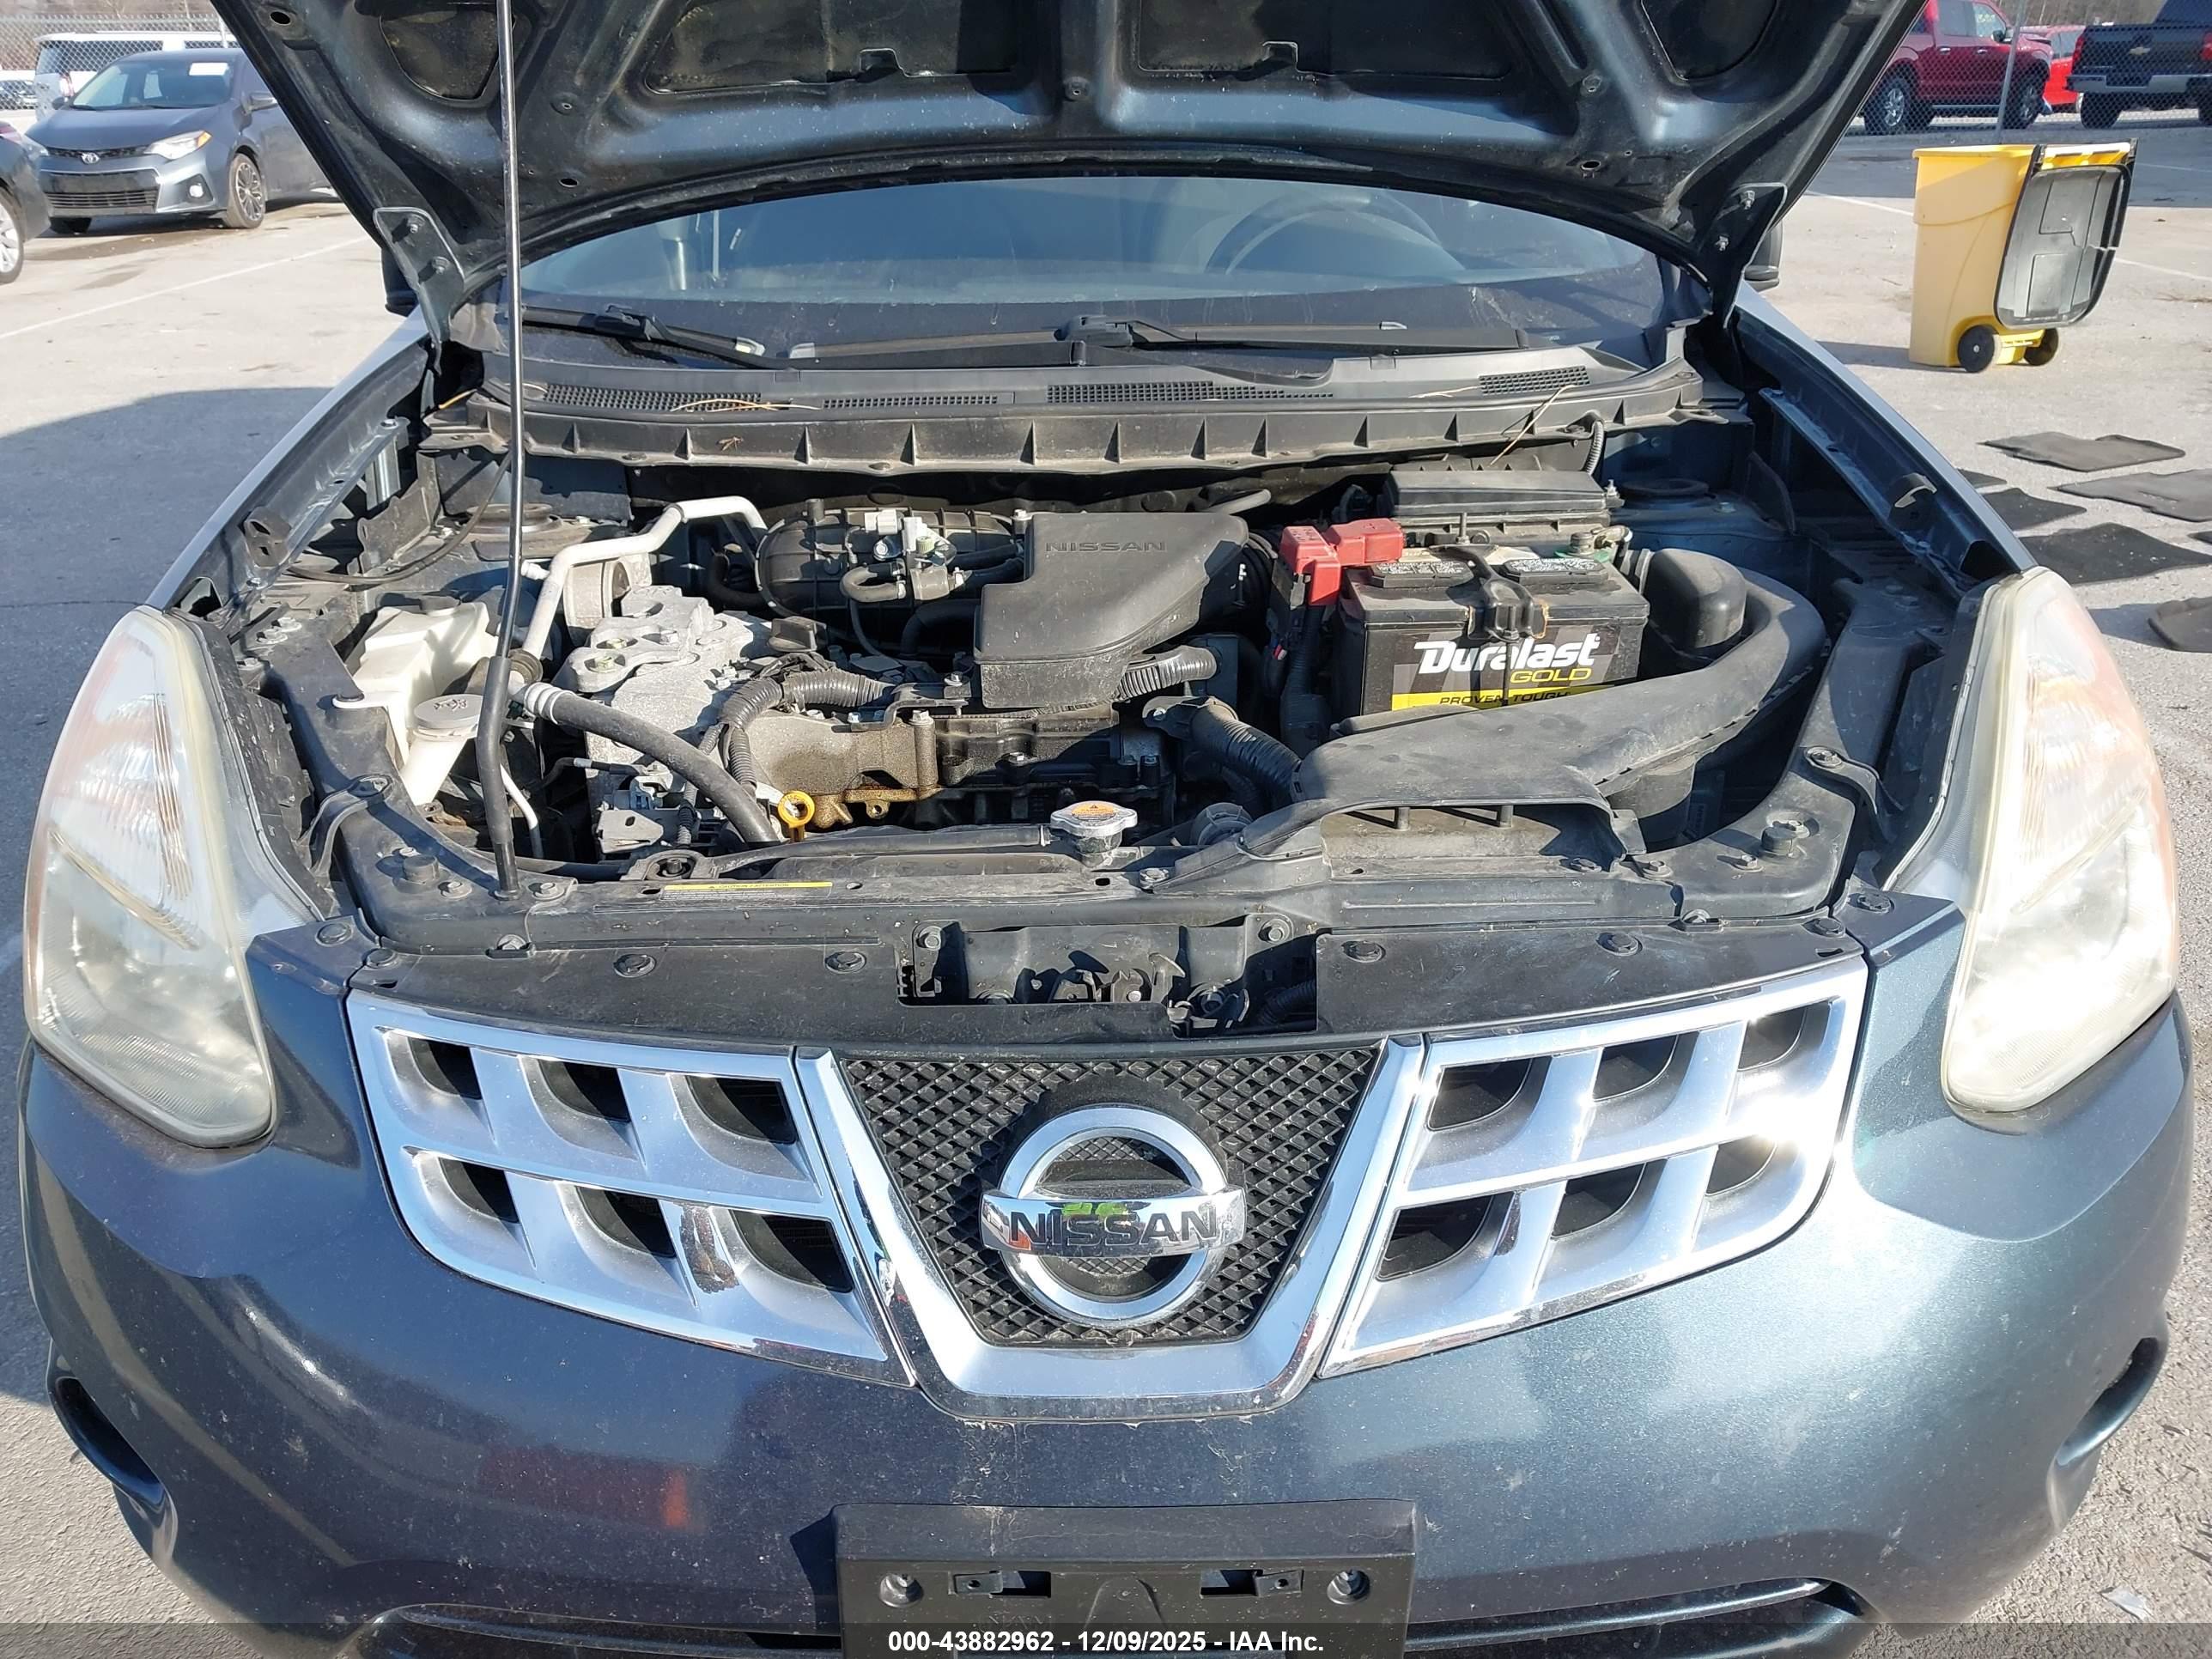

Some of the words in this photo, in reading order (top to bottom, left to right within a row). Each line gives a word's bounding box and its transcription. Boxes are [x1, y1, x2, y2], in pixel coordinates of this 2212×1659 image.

[1045, 542, 1167, 553] NISSAN
[1413, 633, 1601, 674] Duralast
[1510, 668, 1592, 684] GOLD
[1439, 696, 1504, 705] PROVEN
[1010, 1207, 1218, 1245] NISSAN
